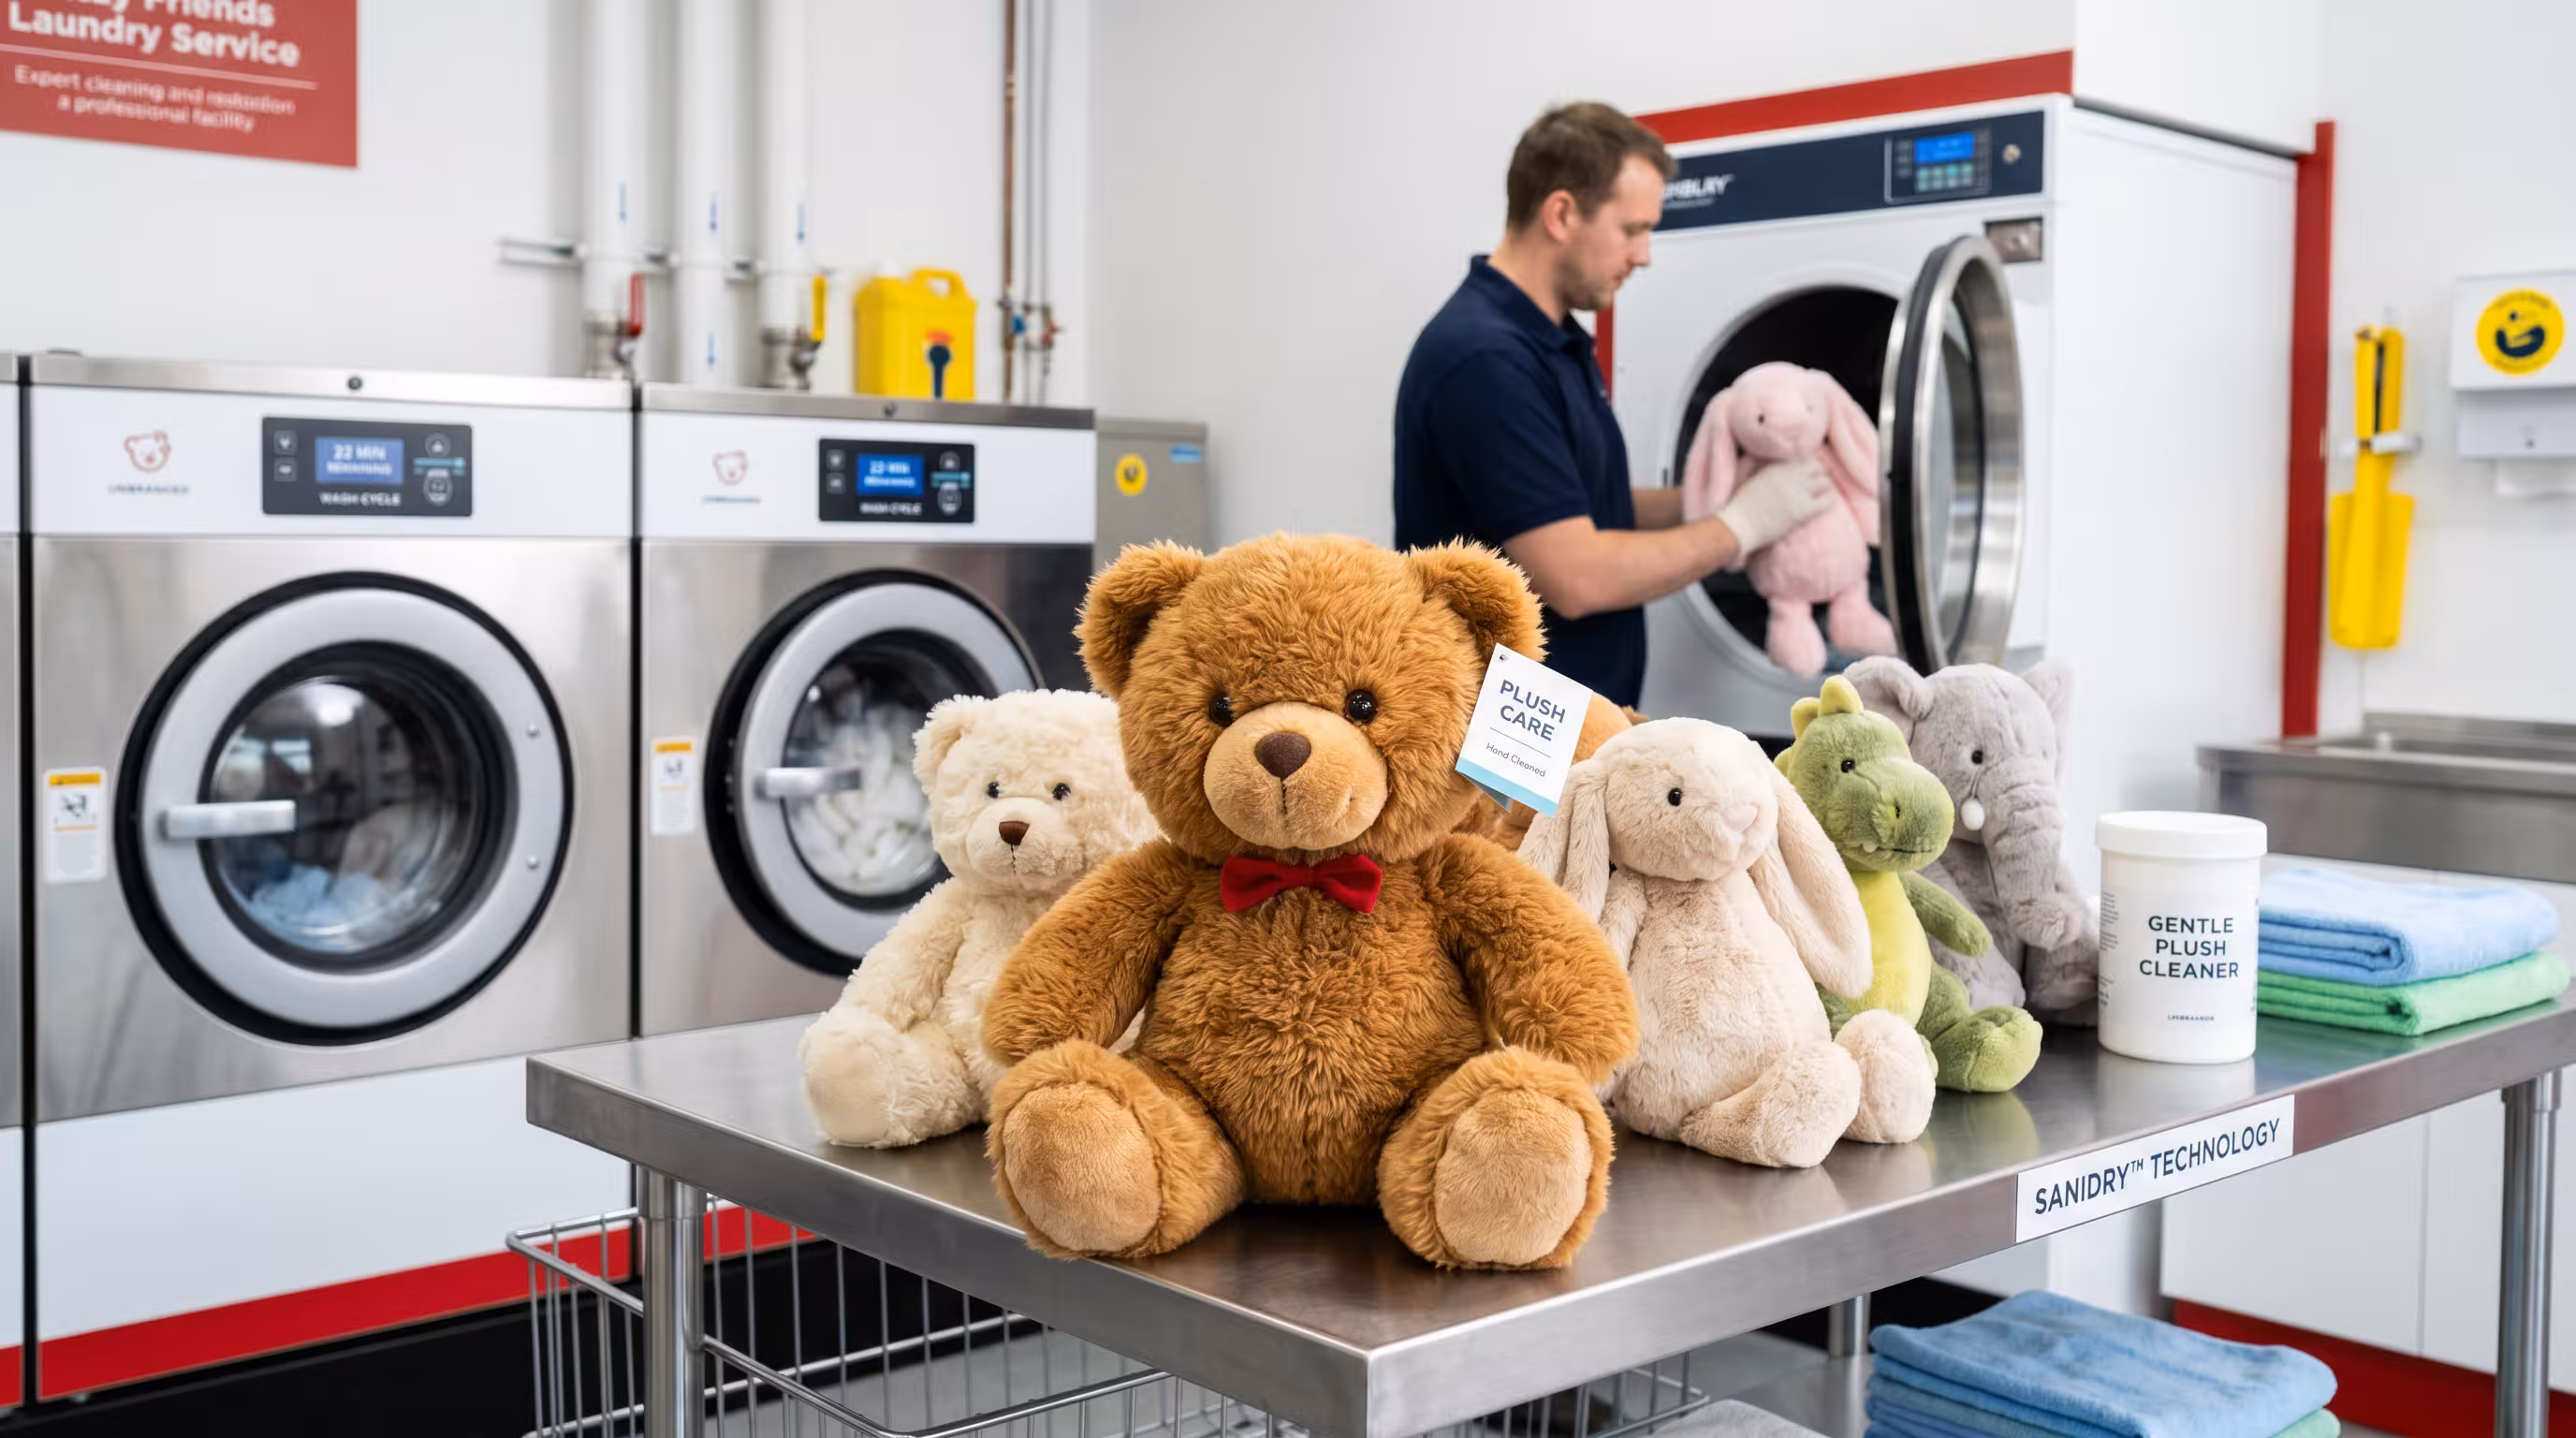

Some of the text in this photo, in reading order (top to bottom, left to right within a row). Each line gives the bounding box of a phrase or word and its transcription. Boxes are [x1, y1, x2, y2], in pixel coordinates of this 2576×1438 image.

[9, 1, 300, 67] Laundry Service
[15, 65, 80, 90] Expert
[84, 75, 165, 103] cleaning
[168, 86, 204, 105] and
[57, 95, 255, 134] a professional facility
[1500, 679, 1566, 723] PLUSH
[1500, 705, 1555, 741] CARE
[1486, 742, 1546, 777] Hand Cleaned
[2147, 915, 2233, 934] GENTLE
[2155, 938, 2226, 957] PLUSH
[2139, 959, 2239, 978] CLEANER
[2150, 1117, 2280, 1180] TECHNOLOGY
